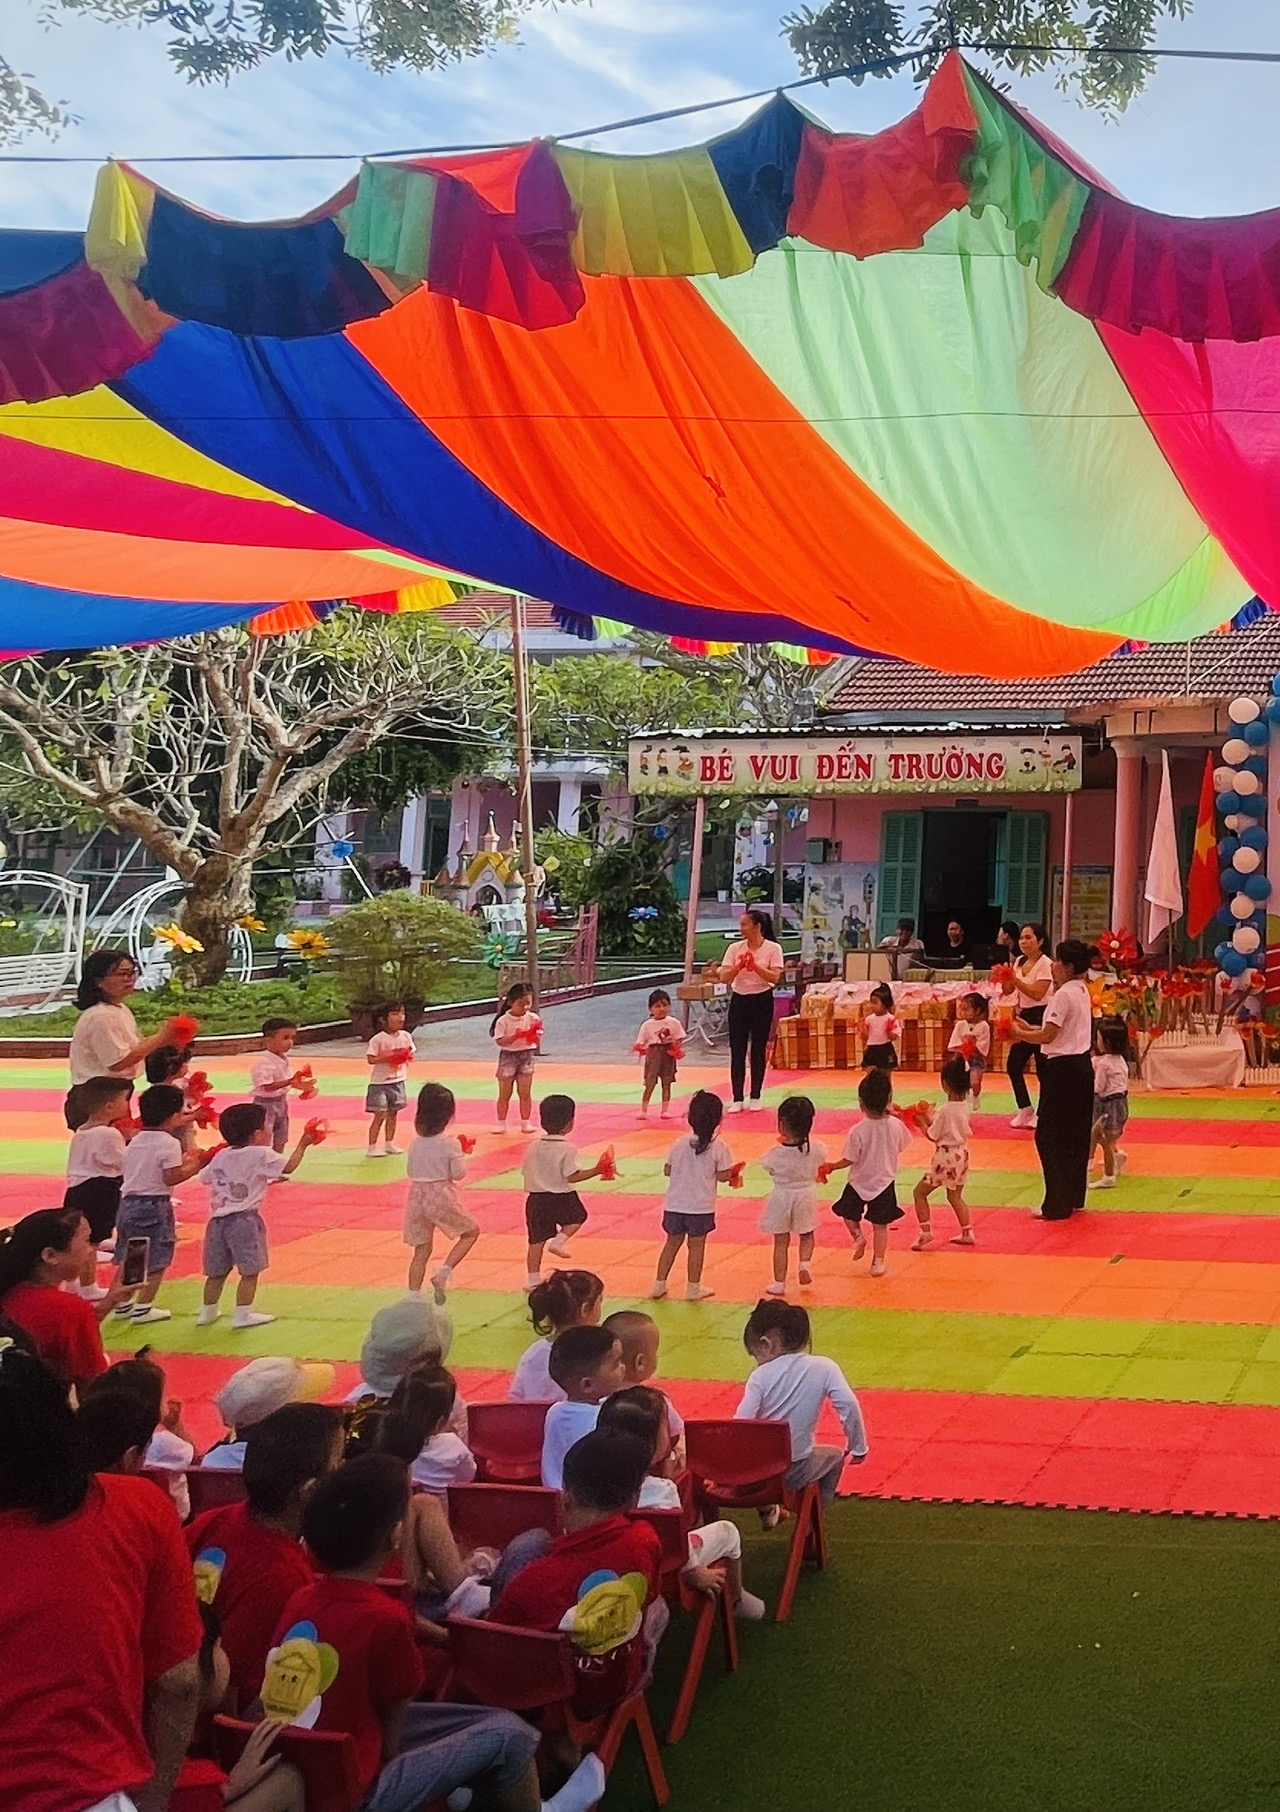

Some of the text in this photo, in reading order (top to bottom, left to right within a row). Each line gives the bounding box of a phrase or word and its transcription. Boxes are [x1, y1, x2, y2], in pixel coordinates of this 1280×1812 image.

[699, 740, 1005, 782] BÉ VUI ĐẾN TRƯỜNG
